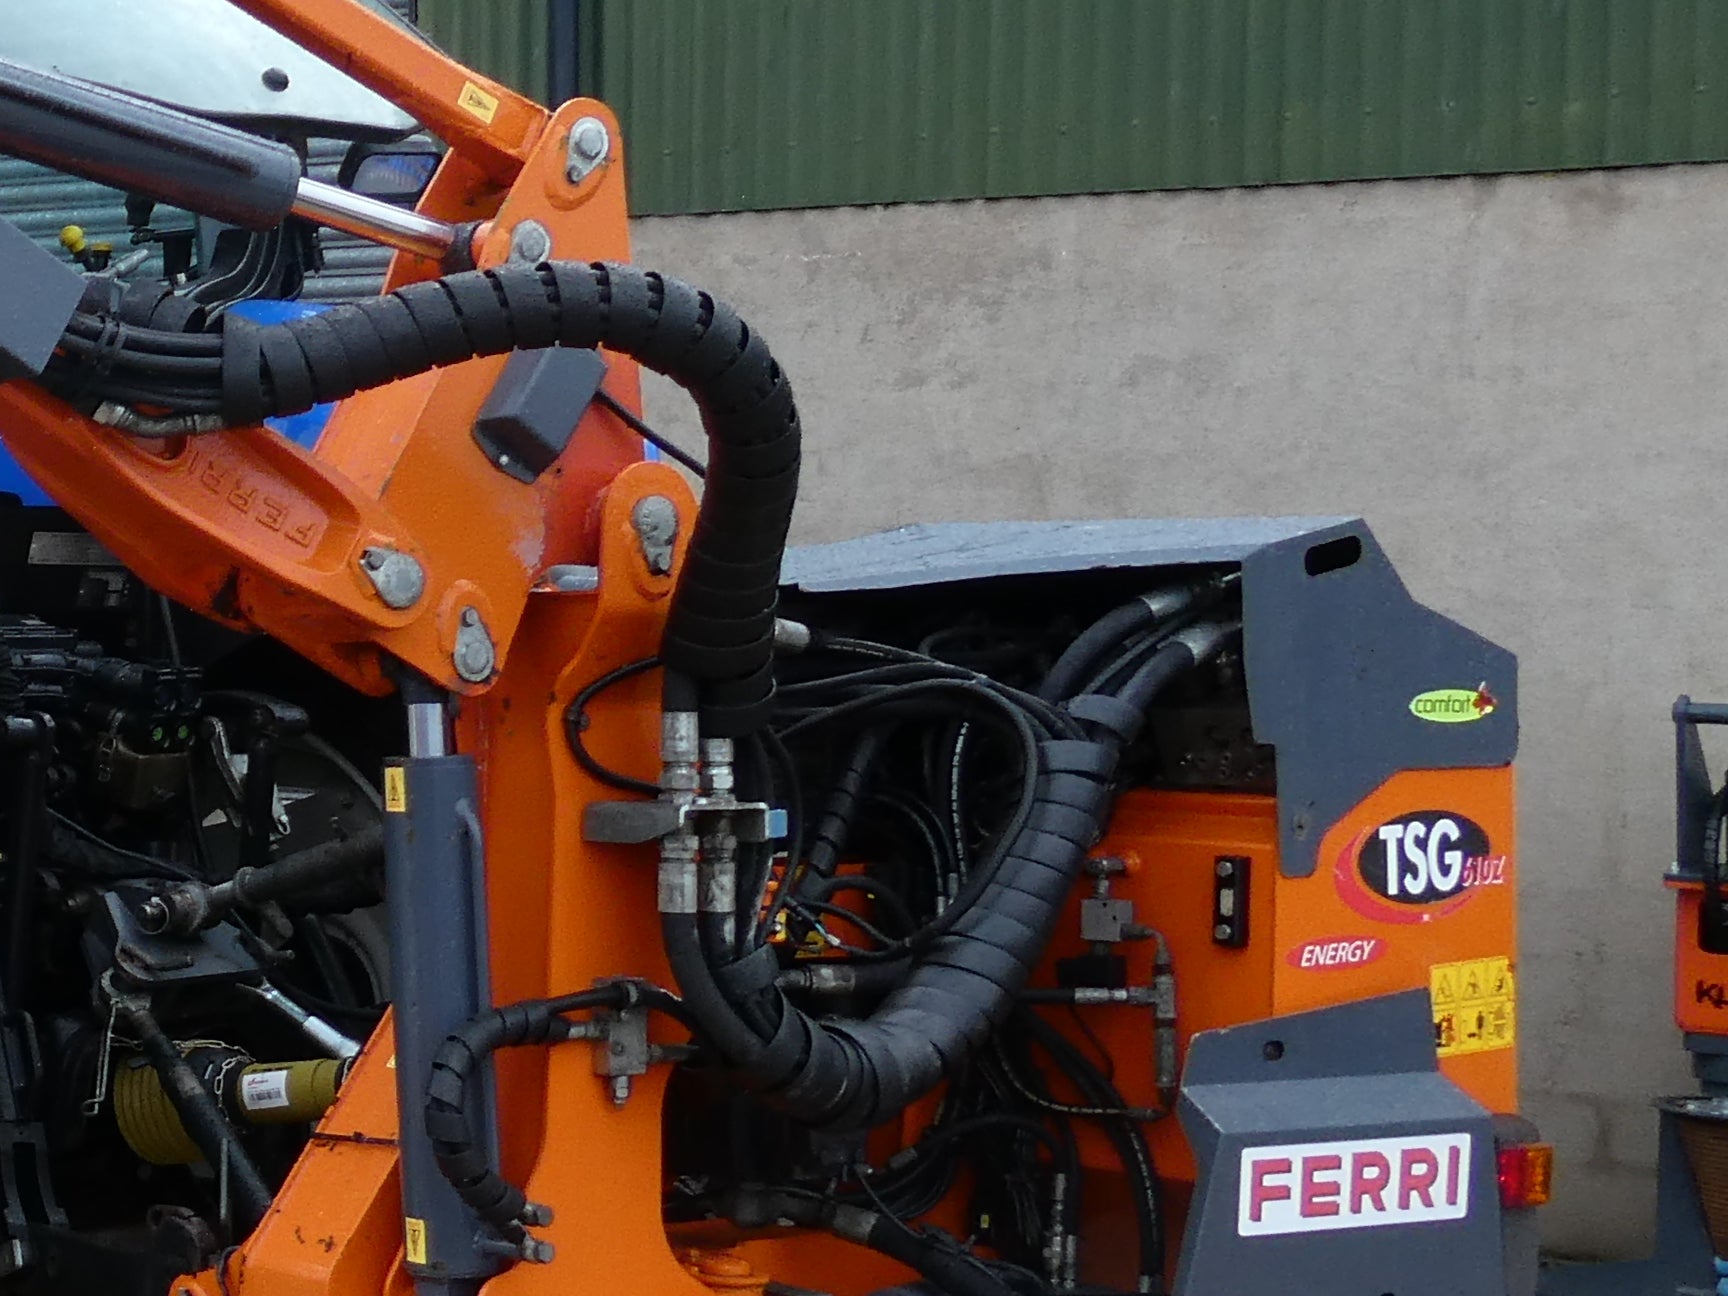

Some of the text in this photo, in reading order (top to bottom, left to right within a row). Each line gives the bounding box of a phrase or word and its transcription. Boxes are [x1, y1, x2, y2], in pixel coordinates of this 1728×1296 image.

[1415, 694, 1471, 714] comfort
[1378, 818, 1463, 896] TSG
[1300, 939, 1375, 967] ENERGY
[1248, 1145, 1461, 1222] FERRI
